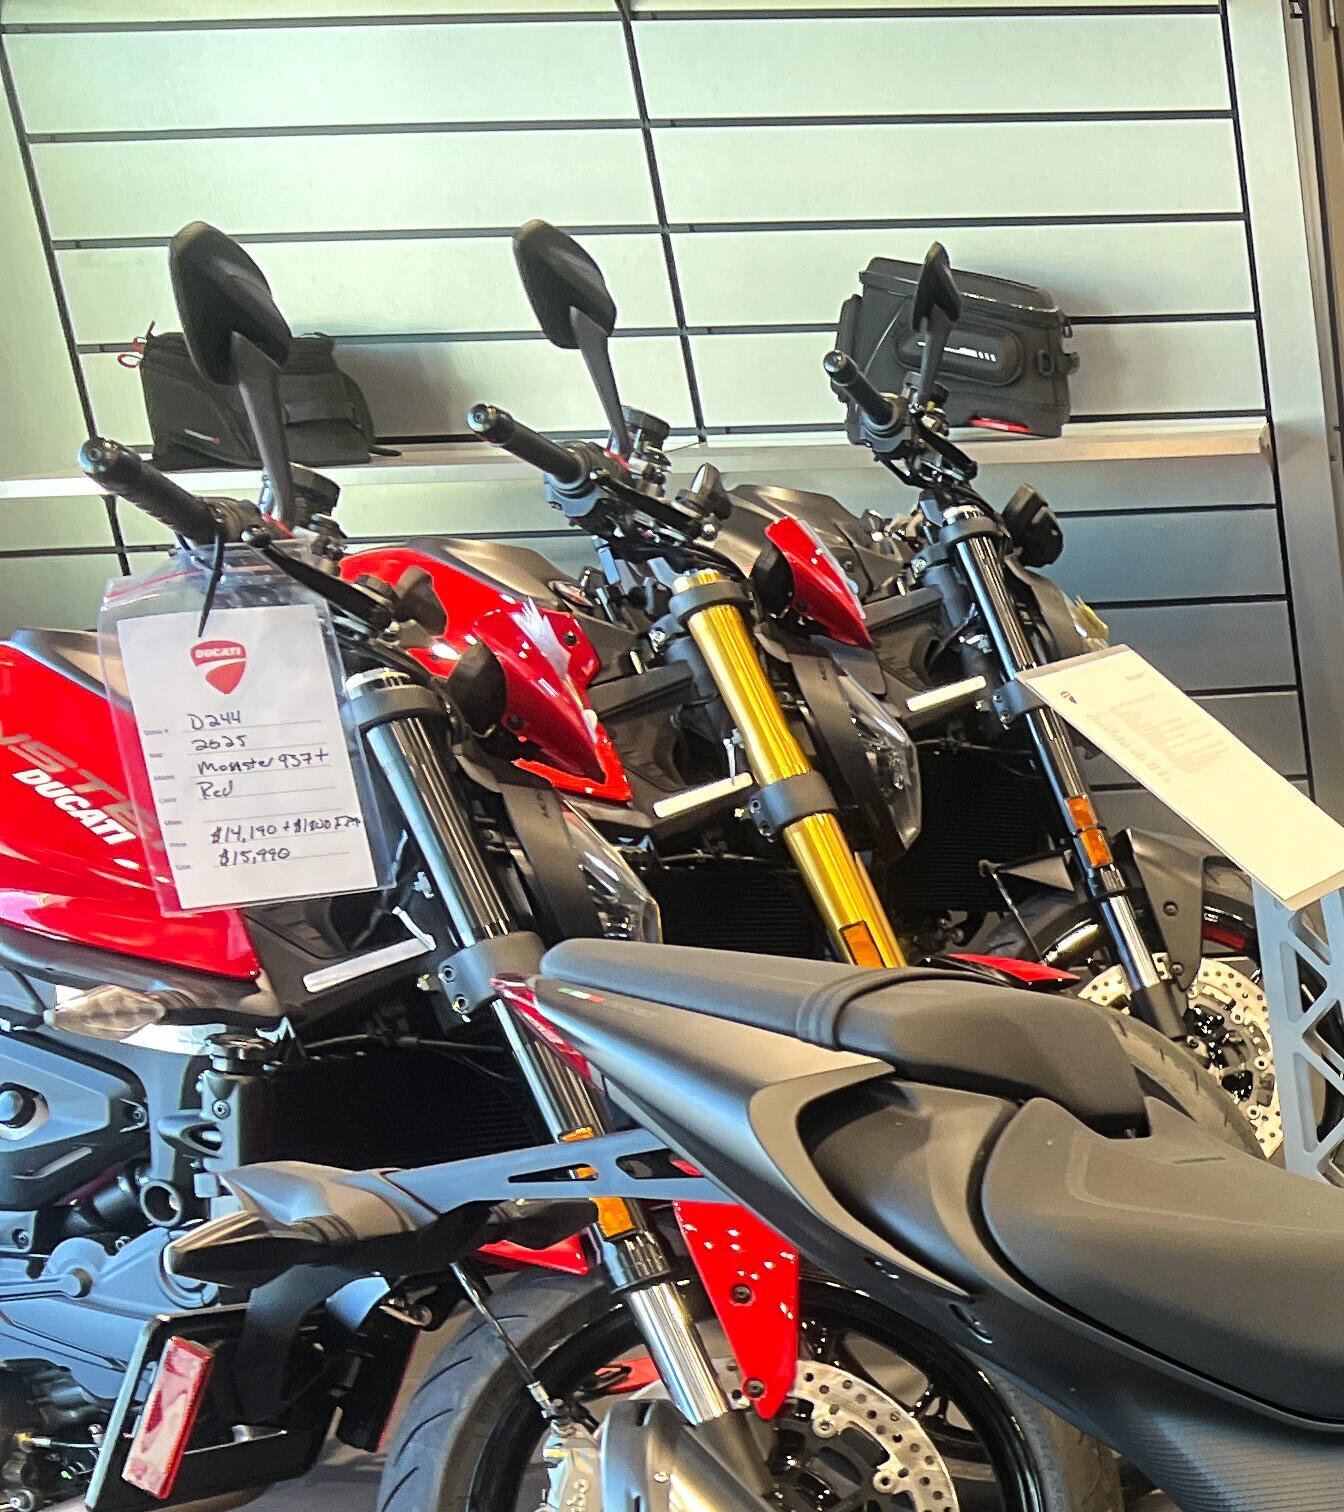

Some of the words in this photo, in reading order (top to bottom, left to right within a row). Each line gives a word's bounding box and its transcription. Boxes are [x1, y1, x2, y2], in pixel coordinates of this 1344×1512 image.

[195, 647, 242, 659] DUCATI
[187, 710, 242, 730] D244
[195, 780, 234, 801] Red
[12, 769, 137, 845] DUCATI
